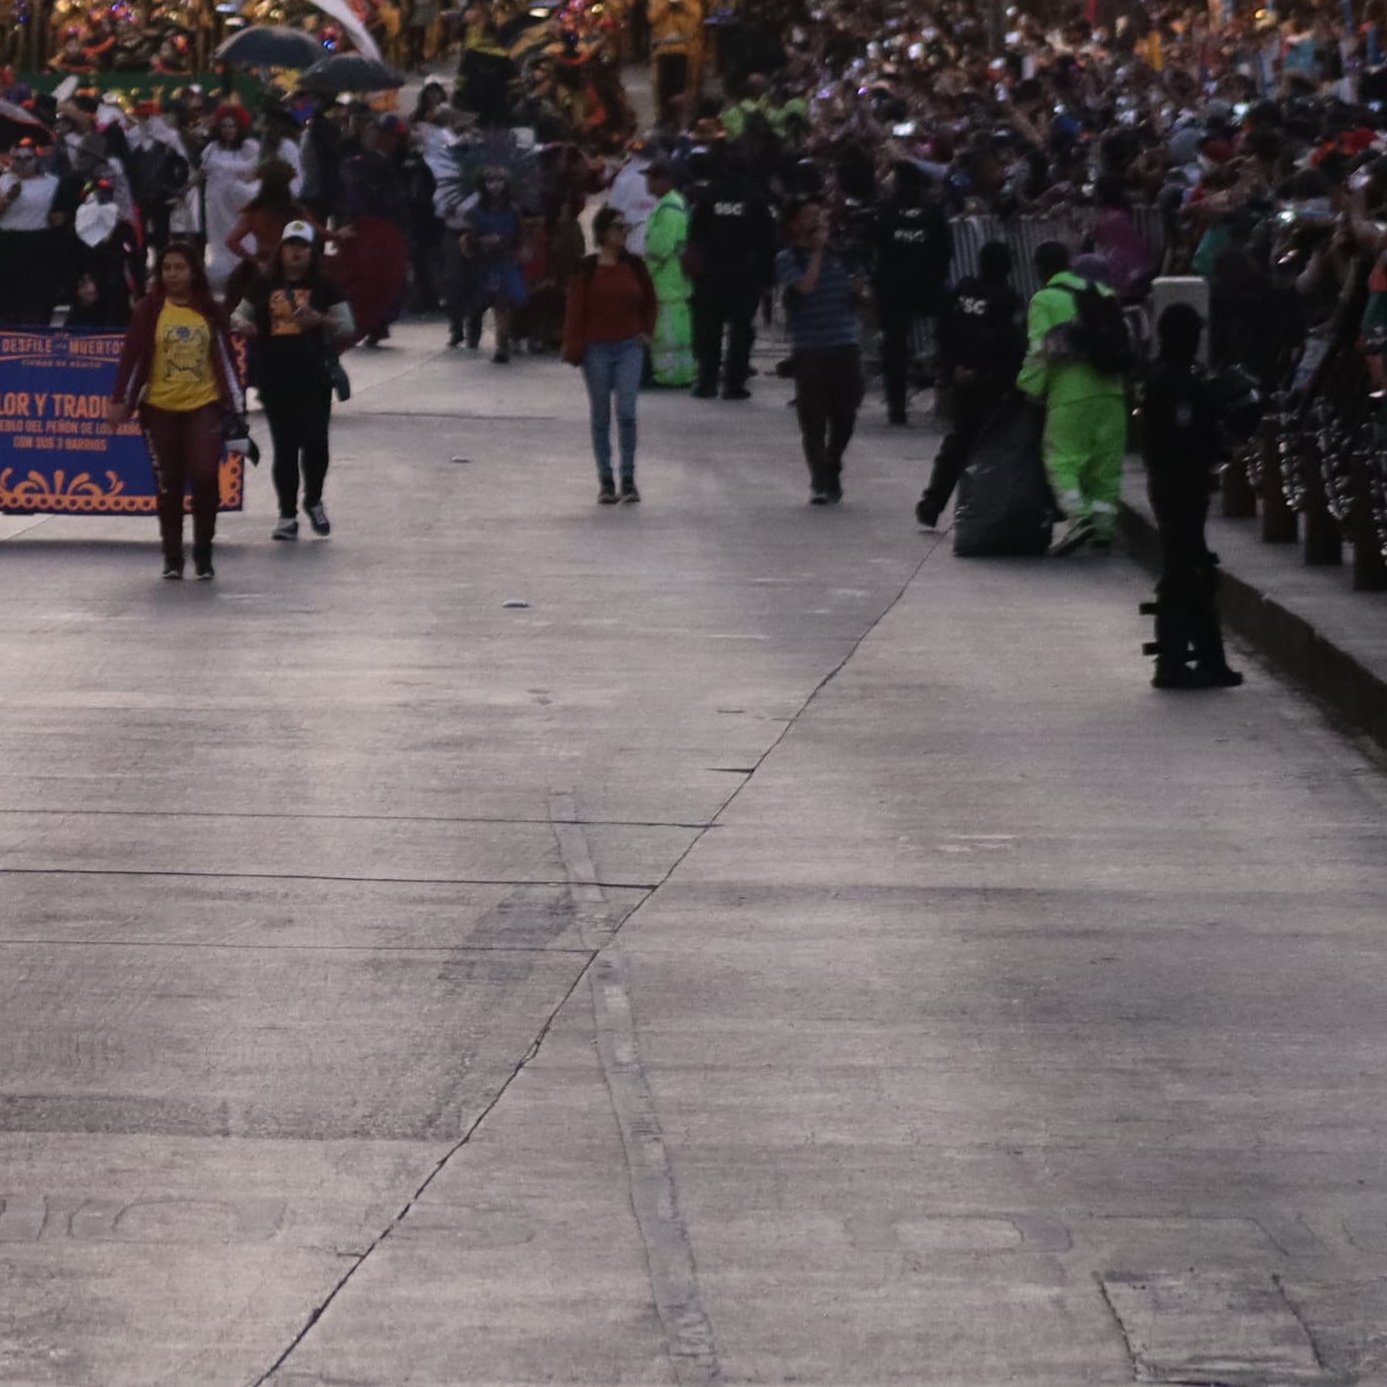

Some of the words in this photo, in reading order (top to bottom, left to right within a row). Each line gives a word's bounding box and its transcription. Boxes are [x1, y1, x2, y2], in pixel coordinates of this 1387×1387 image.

[2, 338, 52, 354] DESFILE
[34, 393, 47, 417] Y
[25, 420, 43, 433] DEL
[80, 421, 93, 435] DE
[13, 435, 33, 448] CON
[36, 436, 55, 449] SUS
